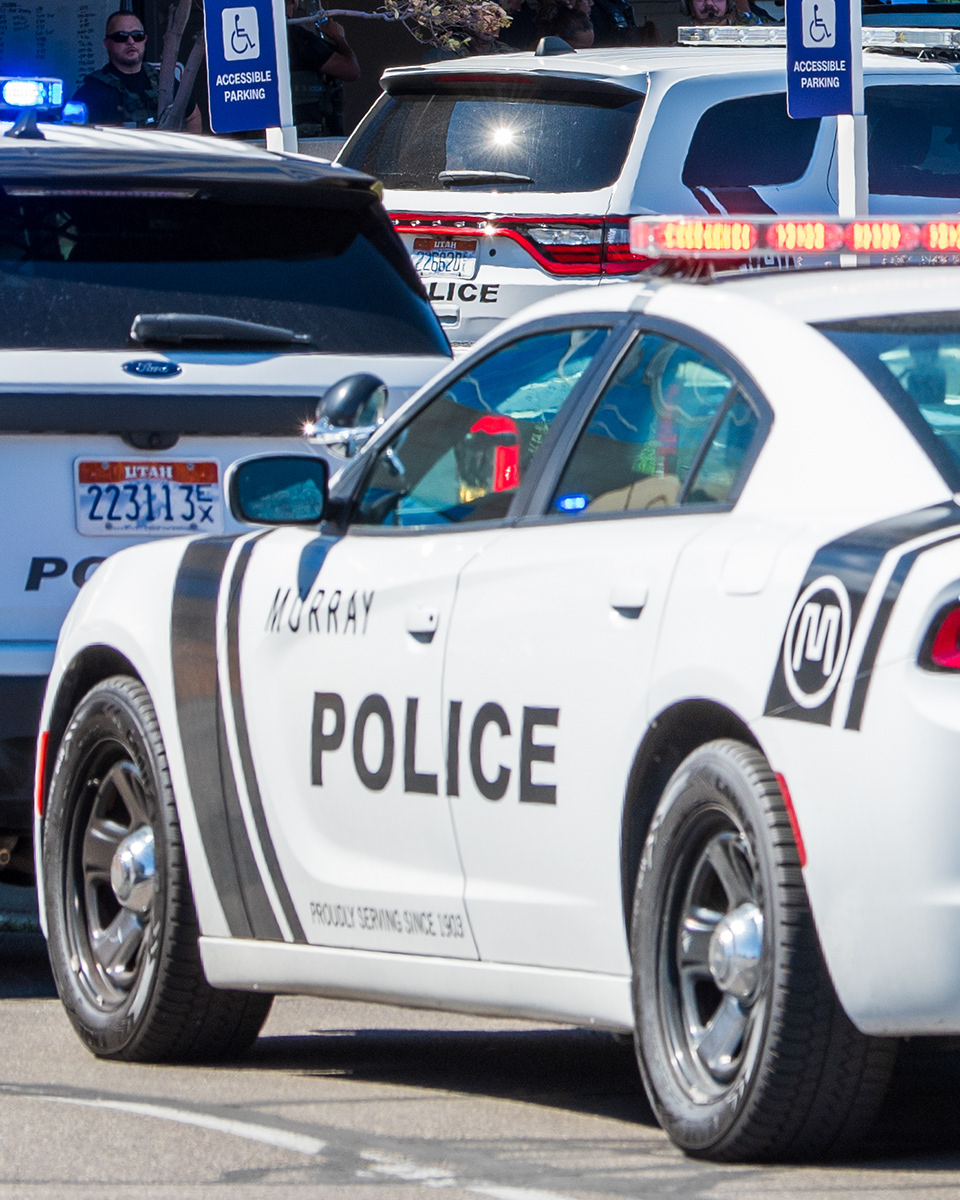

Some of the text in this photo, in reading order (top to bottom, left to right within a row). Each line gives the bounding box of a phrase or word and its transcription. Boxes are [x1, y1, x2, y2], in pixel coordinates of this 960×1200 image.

[793, 60, 847, 72] ACCESSIBLE
[215, 70, 272, 86] ACCESSIBLE
[801, 77, 840, 88] PARKING
[224, 88, 266, 102] PARKING
[434, 240, 457, 249] UTAH
[428, 282, 500, 303] LICE
[137, 361, 169, 375] Ford
[124, 465, 173, 479] UTAH
[87, 484, 195, 522] 223113
[264, 586, 376, 636] MURRAY
[310, 690, 560, 807] POLICE
[310, 901, 465, 939] PROUDLY SERVING SINCE 1903
